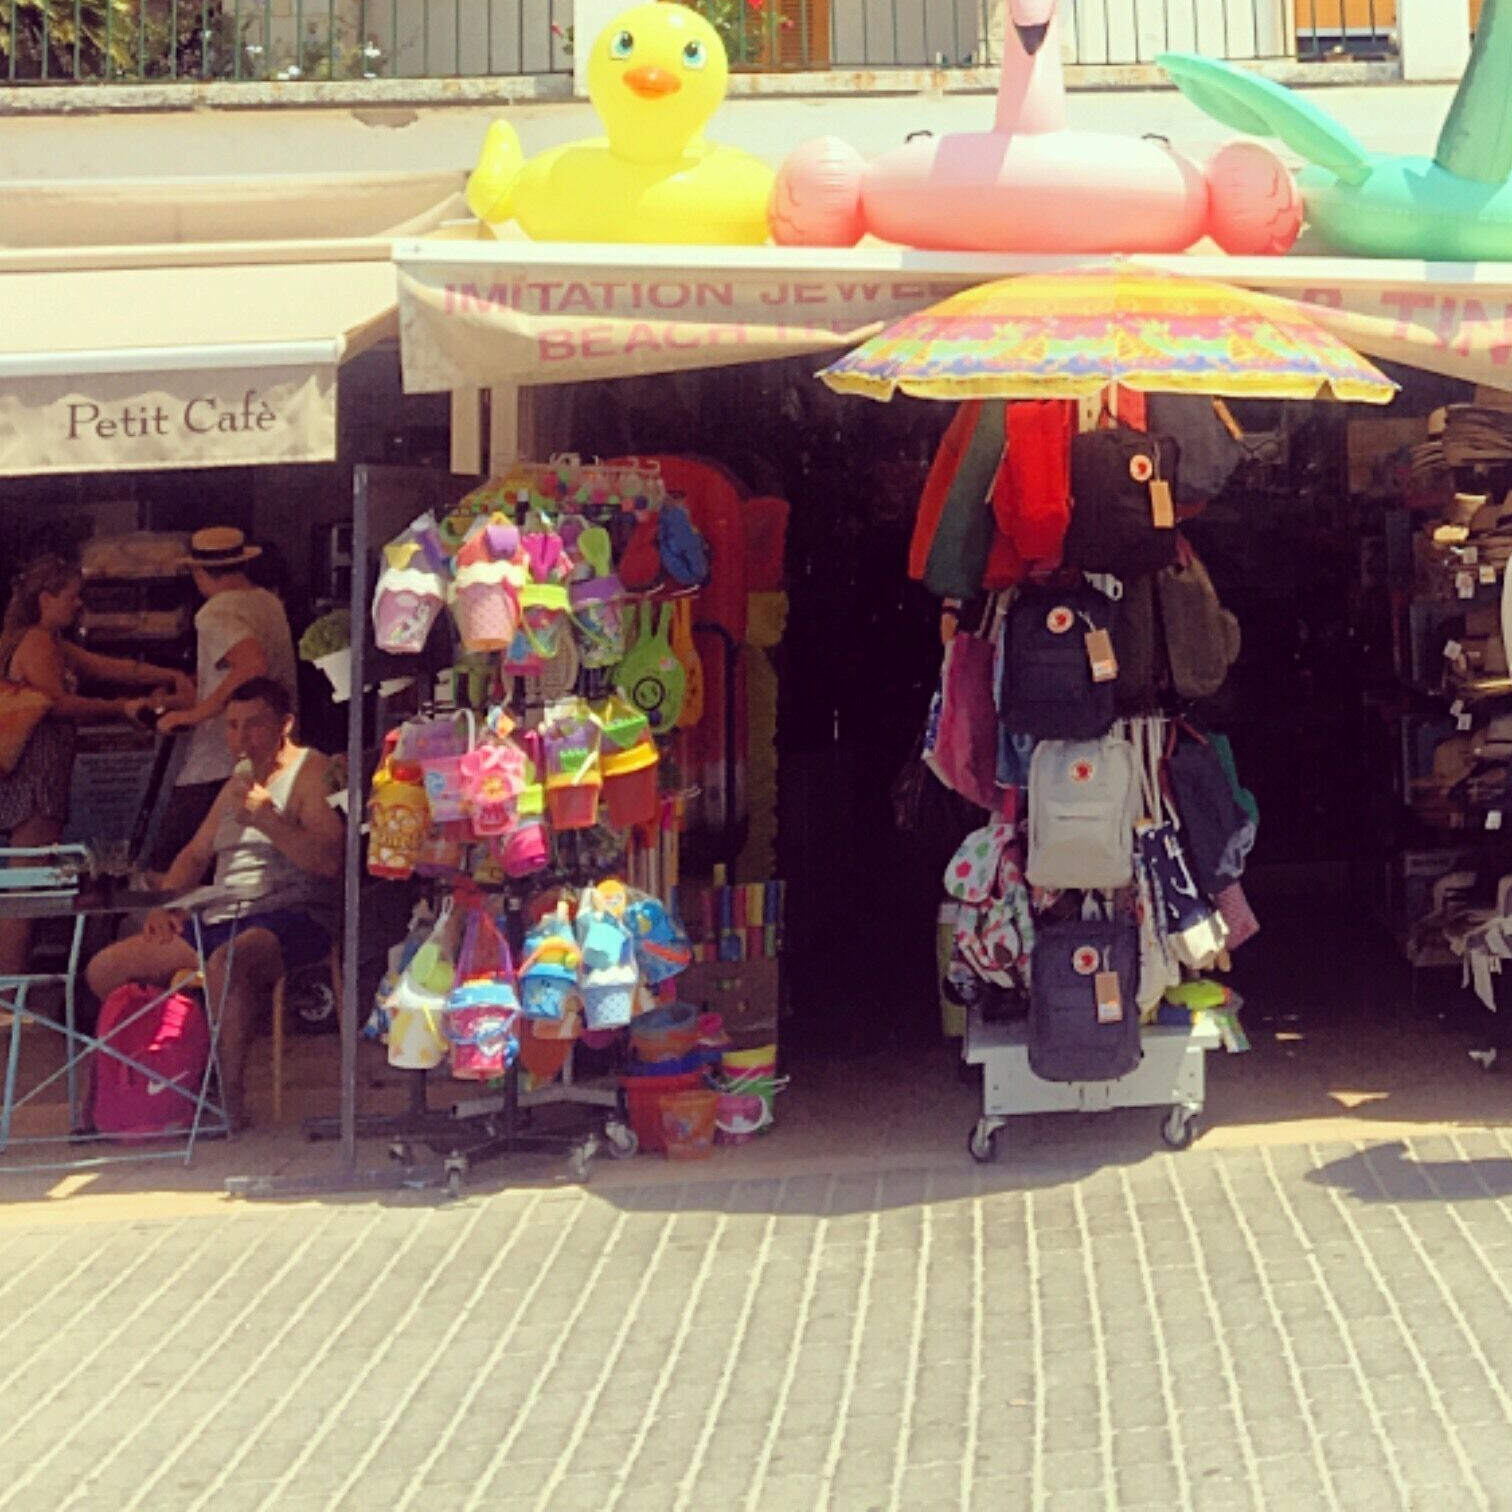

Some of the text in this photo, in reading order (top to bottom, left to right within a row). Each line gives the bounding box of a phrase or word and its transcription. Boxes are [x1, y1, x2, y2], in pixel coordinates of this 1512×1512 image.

[443, 281, 734, 317] IMITATION
[536, 319, 748, 363] BEACH
[67, 402, 170, 441] Petit
